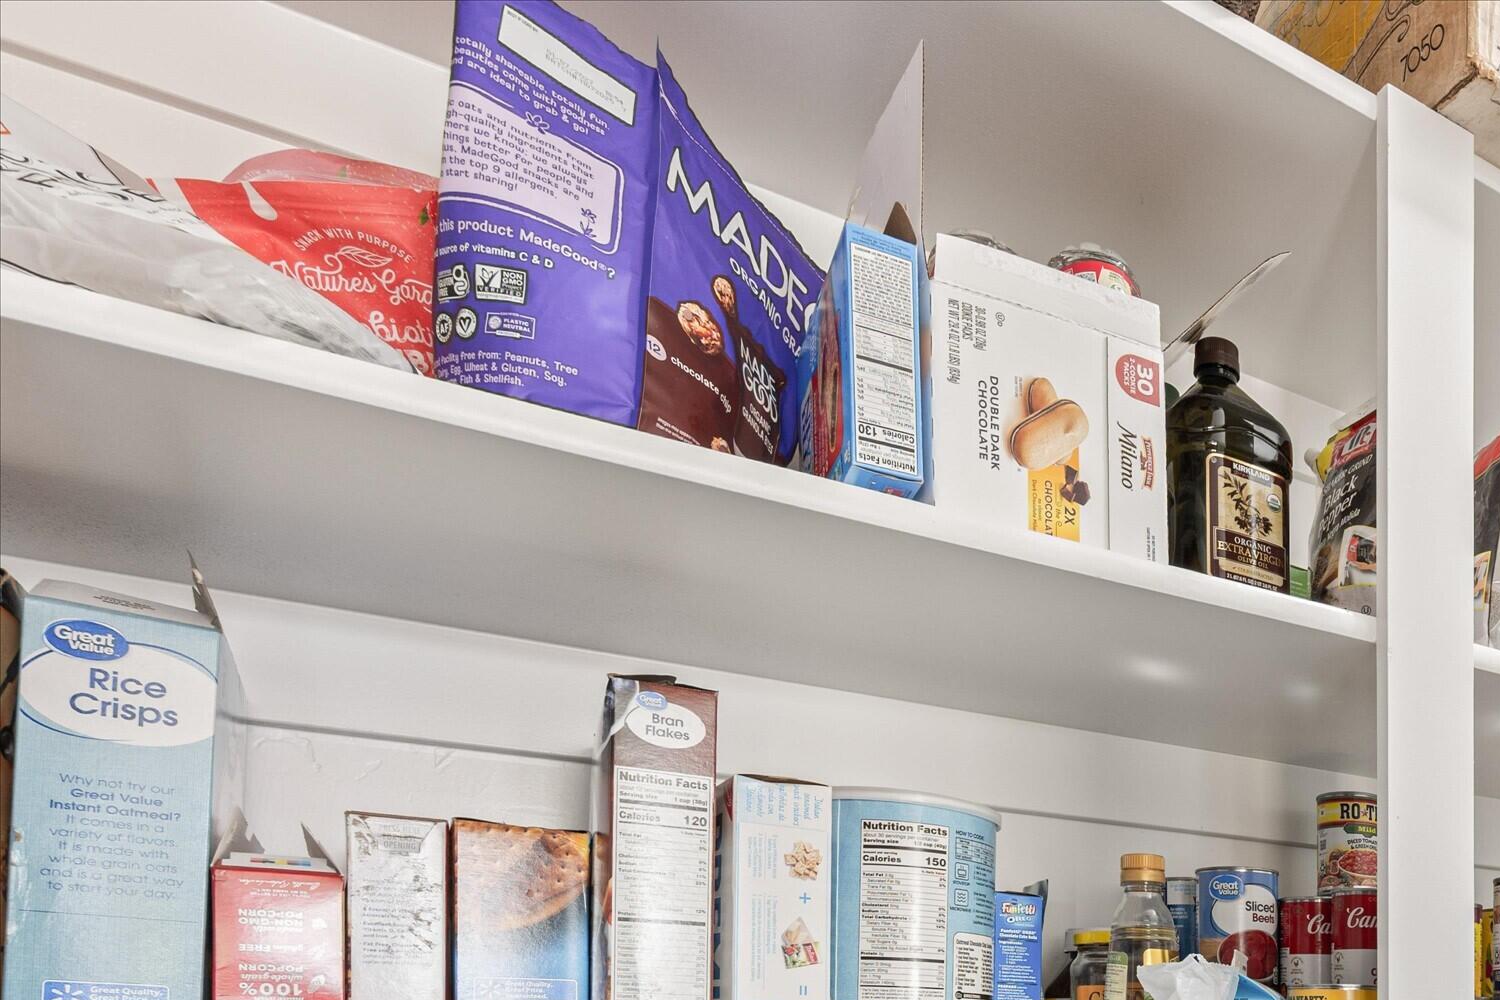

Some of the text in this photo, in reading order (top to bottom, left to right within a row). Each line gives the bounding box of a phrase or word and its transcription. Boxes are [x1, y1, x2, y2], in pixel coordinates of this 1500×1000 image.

[1400, 24, 1445, 82] 7050
[456, 36, 491, 57] totally
[552, 90, 586, 117] totally
[454, 46, 606, 136] beauties come with goodness
[458, 220, 514, 238] product
[294, 227, 415, 264] SNACK WITH PURPOSE
[472, 243, 515, 259] vitamins
[503, 271, 523, 280] NON
[503, 278, 523, 287] GMO
[730, 257, 782, 330] ORGANIC
[554, 361, 578, 376] Tree
[670, 355, 720, 396] chocolate
[1137, 366, 1153, 397] 30
[978, 380, 988, 460] CHOCOLATE
[990, 375, 1000, 470] DOUBLE DARK
[858, 423, 915, 443] Calories 130
[858, 452, 916, 472] Nutrition Facts
[1117, 420, 1138, 491] Milano
[1232, 462, 1270, 481] KIRKLAND
[1217, 540, 1284, 568] EXTRA VIRGIN
[1234, 536, 1271, 554] ORGANIC
[1237, 554, 1268, 569] OLIVE OIL
[53, 623, 116, 650] Great
[68, 638, 116, 658] Value
[88, 666, 167, 699] Rice
[69, 693, 178, 728] Crisps
[652, 713, 684, 727] Bran
[645, 725, 690, 741] Flakes
[59, 773, 175, 795] Why not try our
[619, 771, 708, 791] Nutrition Facts
[70, 788, 163, 806] Great Value
[49, 800, 182, 822] Instant Oatmeal?
[619, 811, 707, 826] Calories 120
[863, 822, 947, 836] Nutrition Facts
[863, 855, 946, 866] Calories 150
[1212, 880, 1239, 891] Great
[1218, 888, 1239, 896] Value
[1245, 901, 1275, 914] Sliced
[1252, 912, 1275, 925] Beets
[238, 962, 304, 973] POPCORN
[239, 982, 304, 996] 100%
